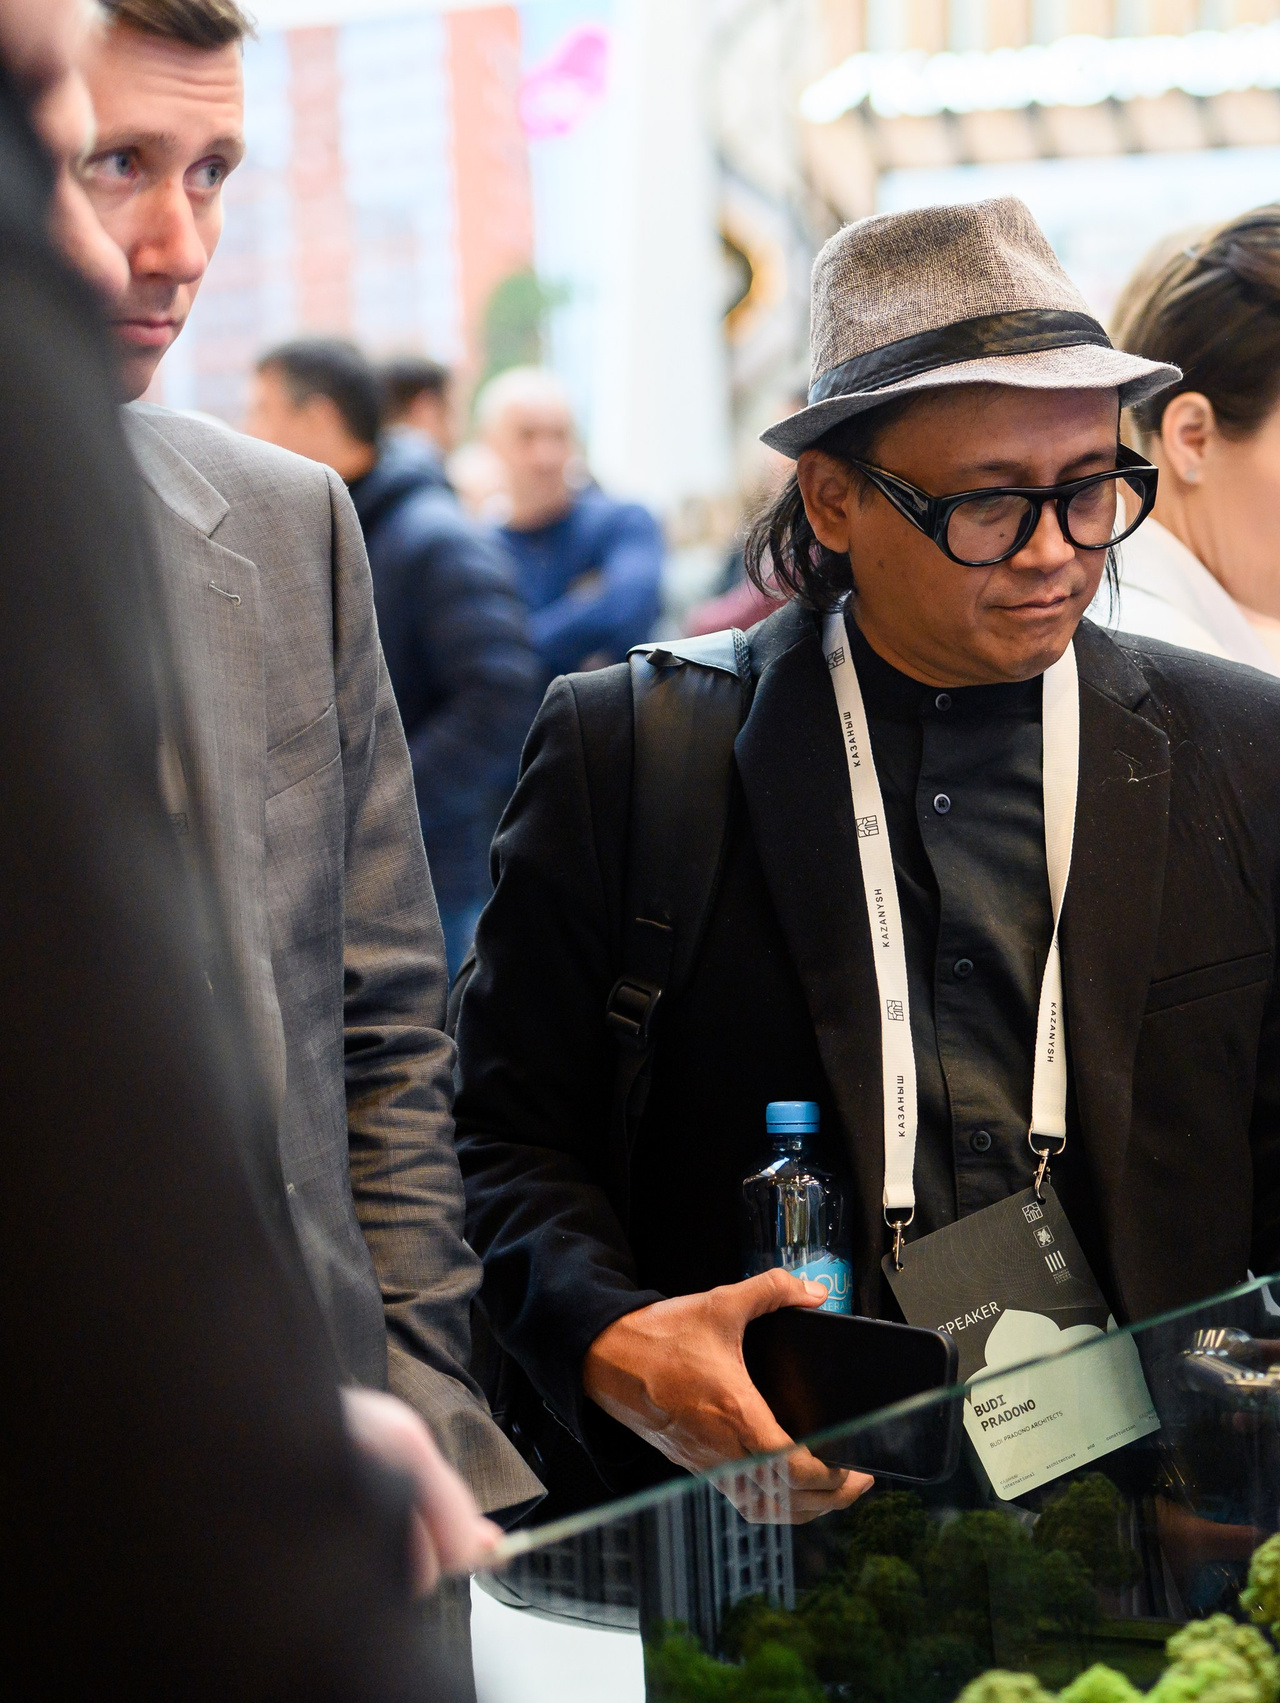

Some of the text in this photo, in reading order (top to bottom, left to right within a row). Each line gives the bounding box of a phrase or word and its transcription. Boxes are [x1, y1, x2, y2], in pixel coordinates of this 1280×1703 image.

[843, 711, 861, 767] КАЗАНЫШ
[874, 888, 890, 948] KAZANYSH
[1047, 1002, 1057, 1063] KAZANYSH
[896, 1075, 905, 1138] КАЗАНЫШ
[937, 1301, 1001, 1335] SPEAKER
[973, 1394, 1007, 1417] BUDI
[980, 1399, 1036, 1432] PRADONO
[989, 1410, 1064, 1449] BUDI PRADONO ARCHITECTS
